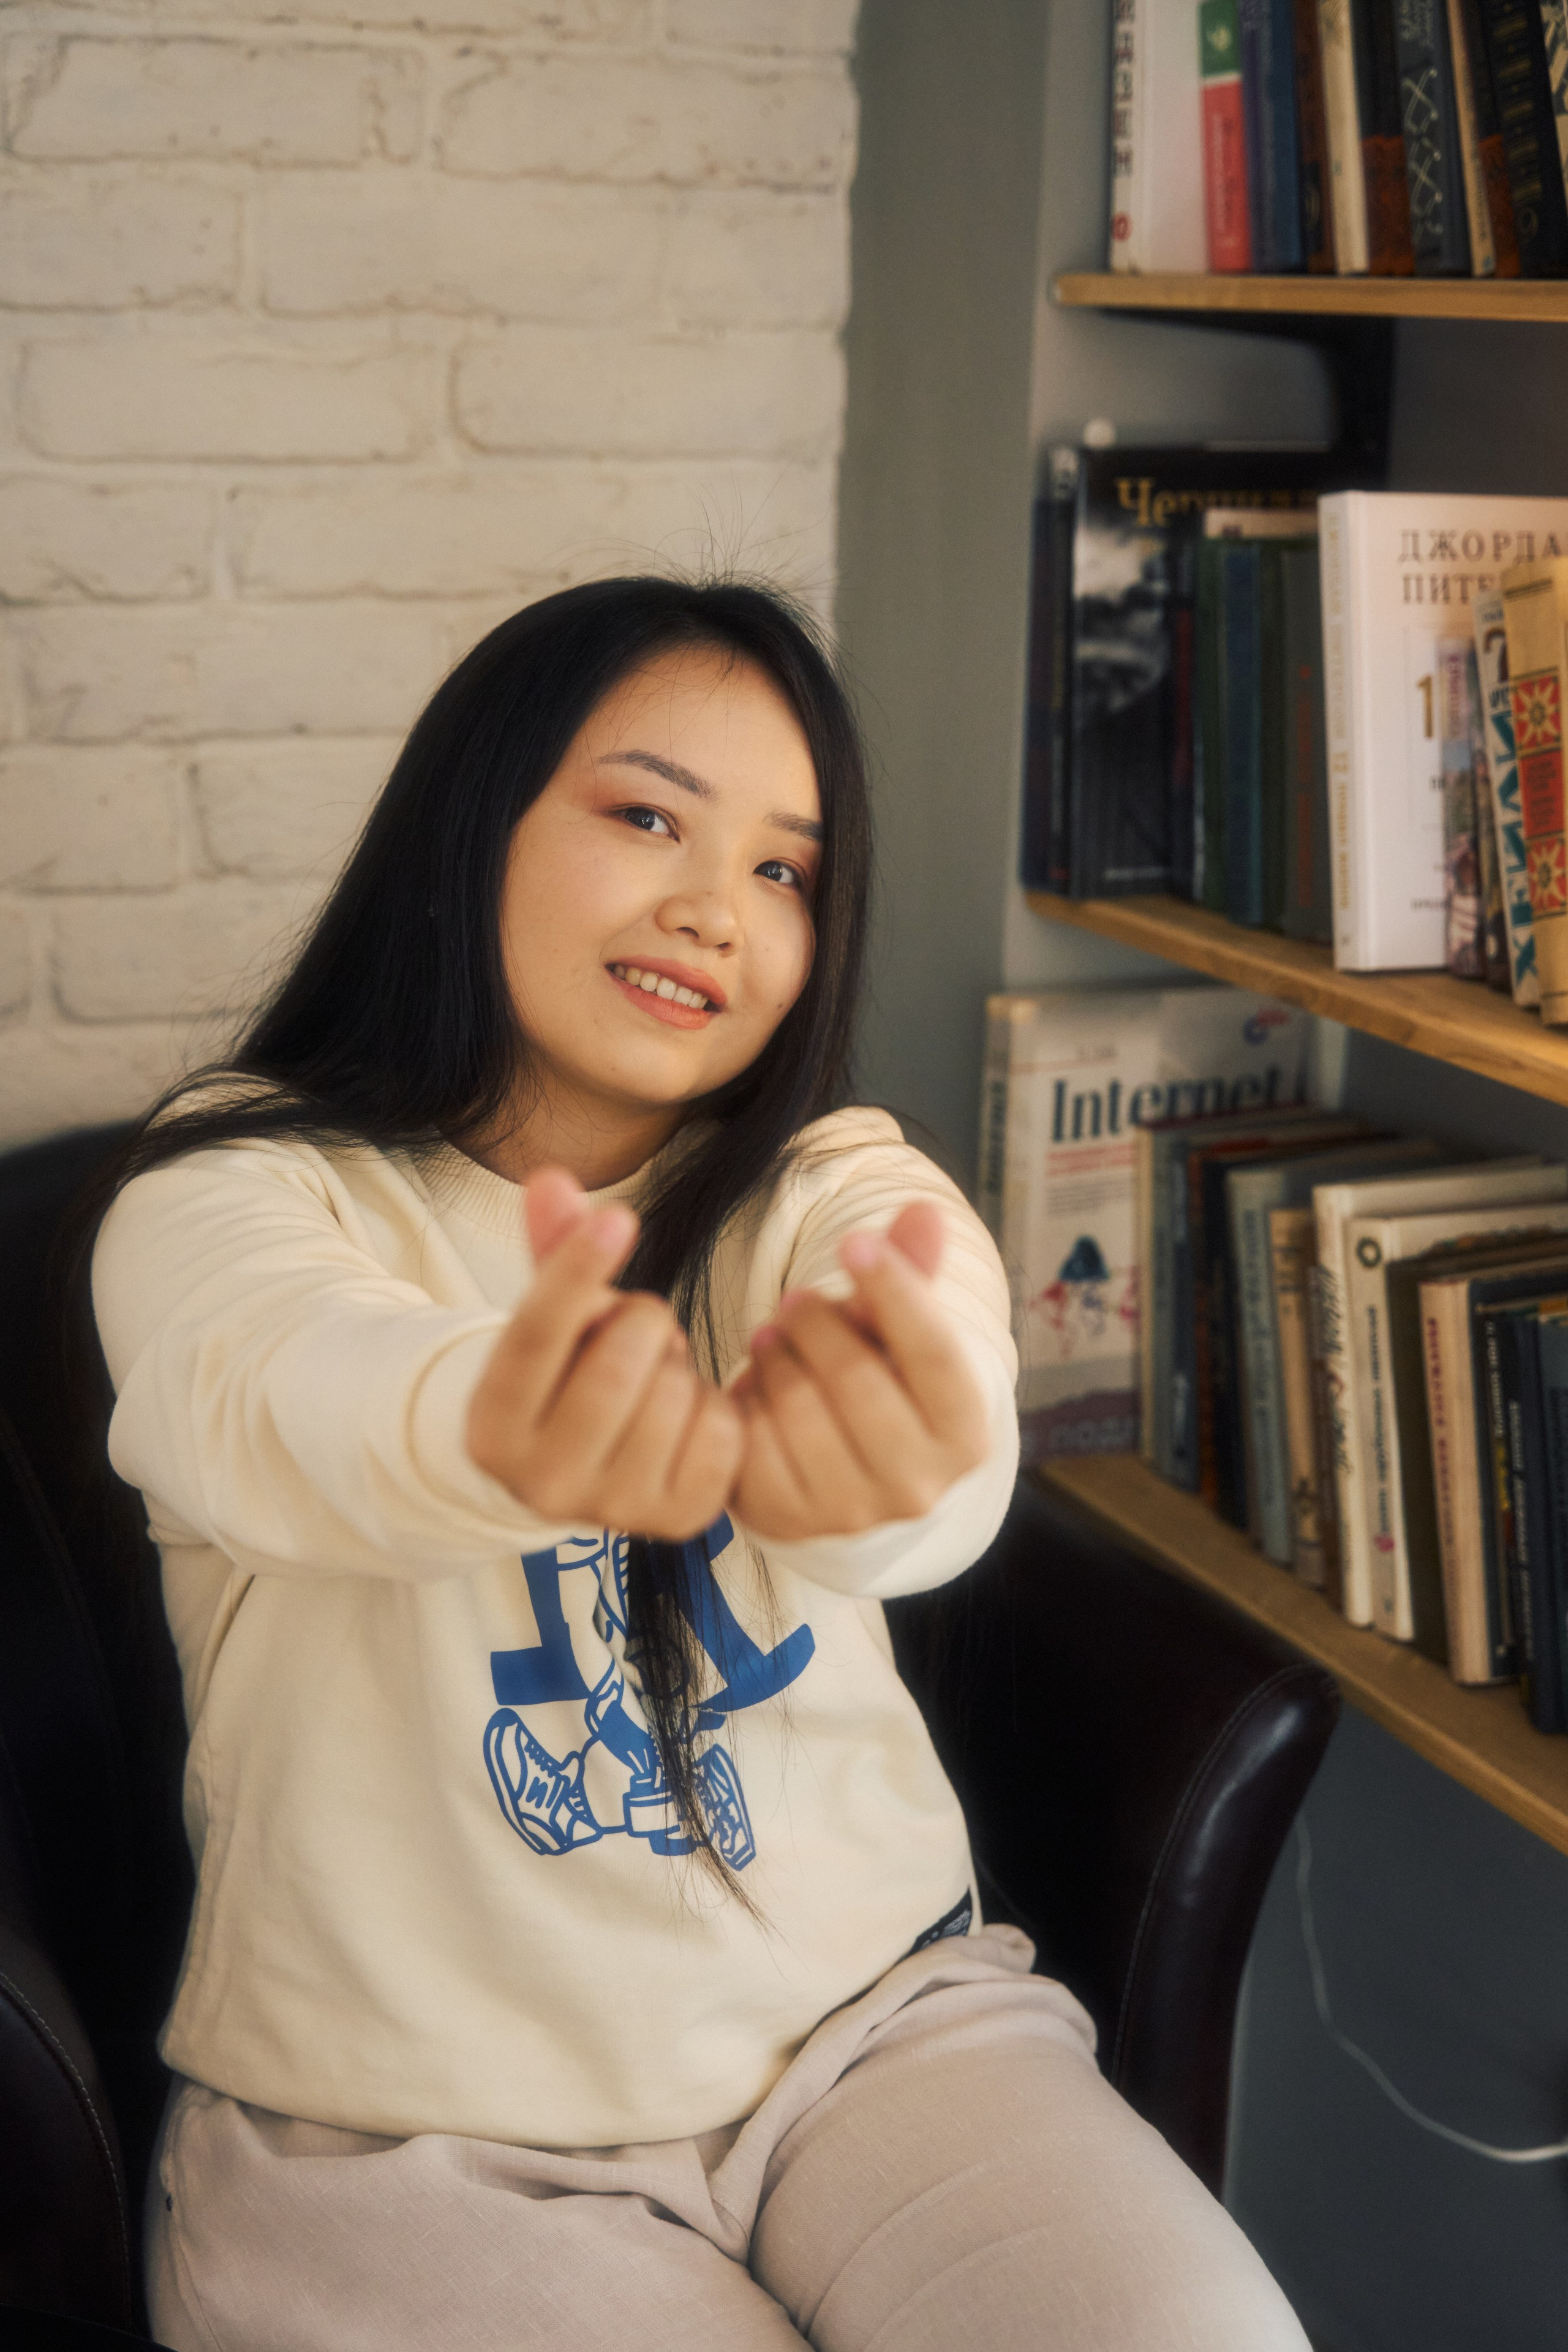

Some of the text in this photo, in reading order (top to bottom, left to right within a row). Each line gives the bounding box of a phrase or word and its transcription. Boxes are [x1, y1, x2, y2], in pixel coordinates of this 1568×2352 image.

[1396, 529, 1568, 564] ДЖОРДА
[1402, 573, 1499, 605] ПИТЕ
[1051, 1066, 1283, 1144] Internet
